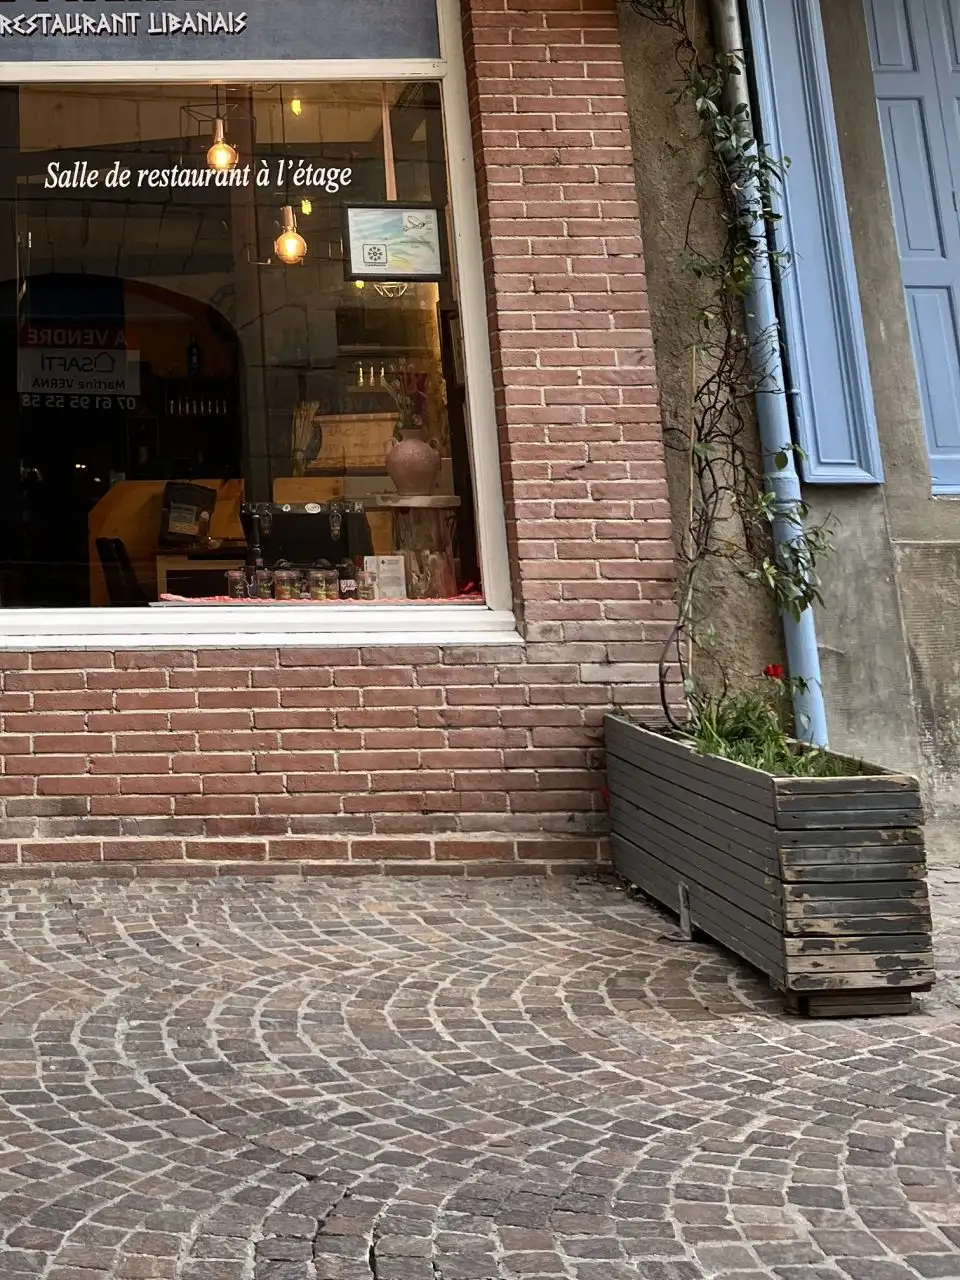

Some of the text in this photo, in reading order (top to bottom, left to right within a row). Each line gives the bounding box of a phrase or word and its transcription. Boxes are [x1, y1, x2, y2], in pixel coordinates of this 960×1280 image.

[147, 11, 247, 35] LIBANAIS
[44, 159, 352, 193] Salle de restaurant à l'étage
